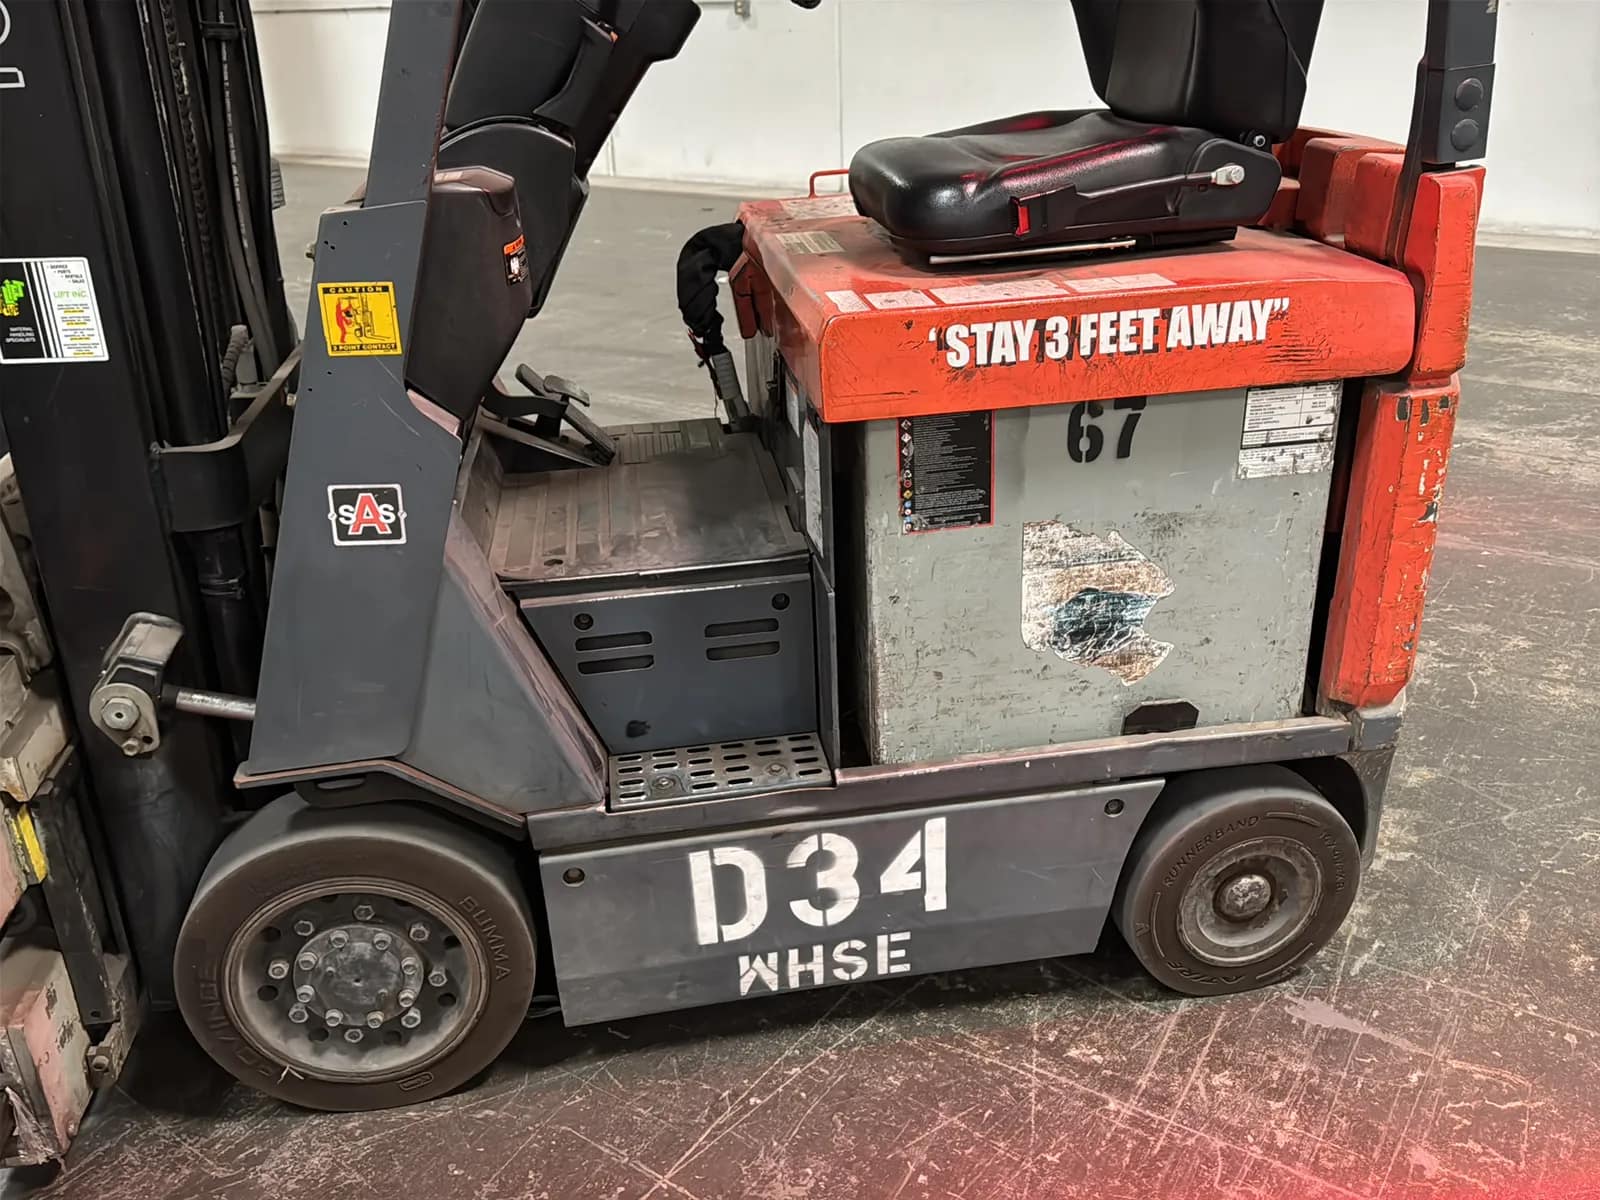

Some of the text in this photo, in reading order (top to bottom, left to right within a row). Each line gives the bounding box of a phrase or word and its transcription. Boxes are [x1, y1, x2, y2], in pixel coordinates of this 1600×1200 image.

[1045, 315, 1069, 359] 3
[1080, 308, 1161, 357] FEET
[1067, 396, 1147, 463] 67
[688, 816, 948, 945] D34
[1163, 815, 1261, 888] RUNNERBAND
[738, 930, 911, 996] WHSE
